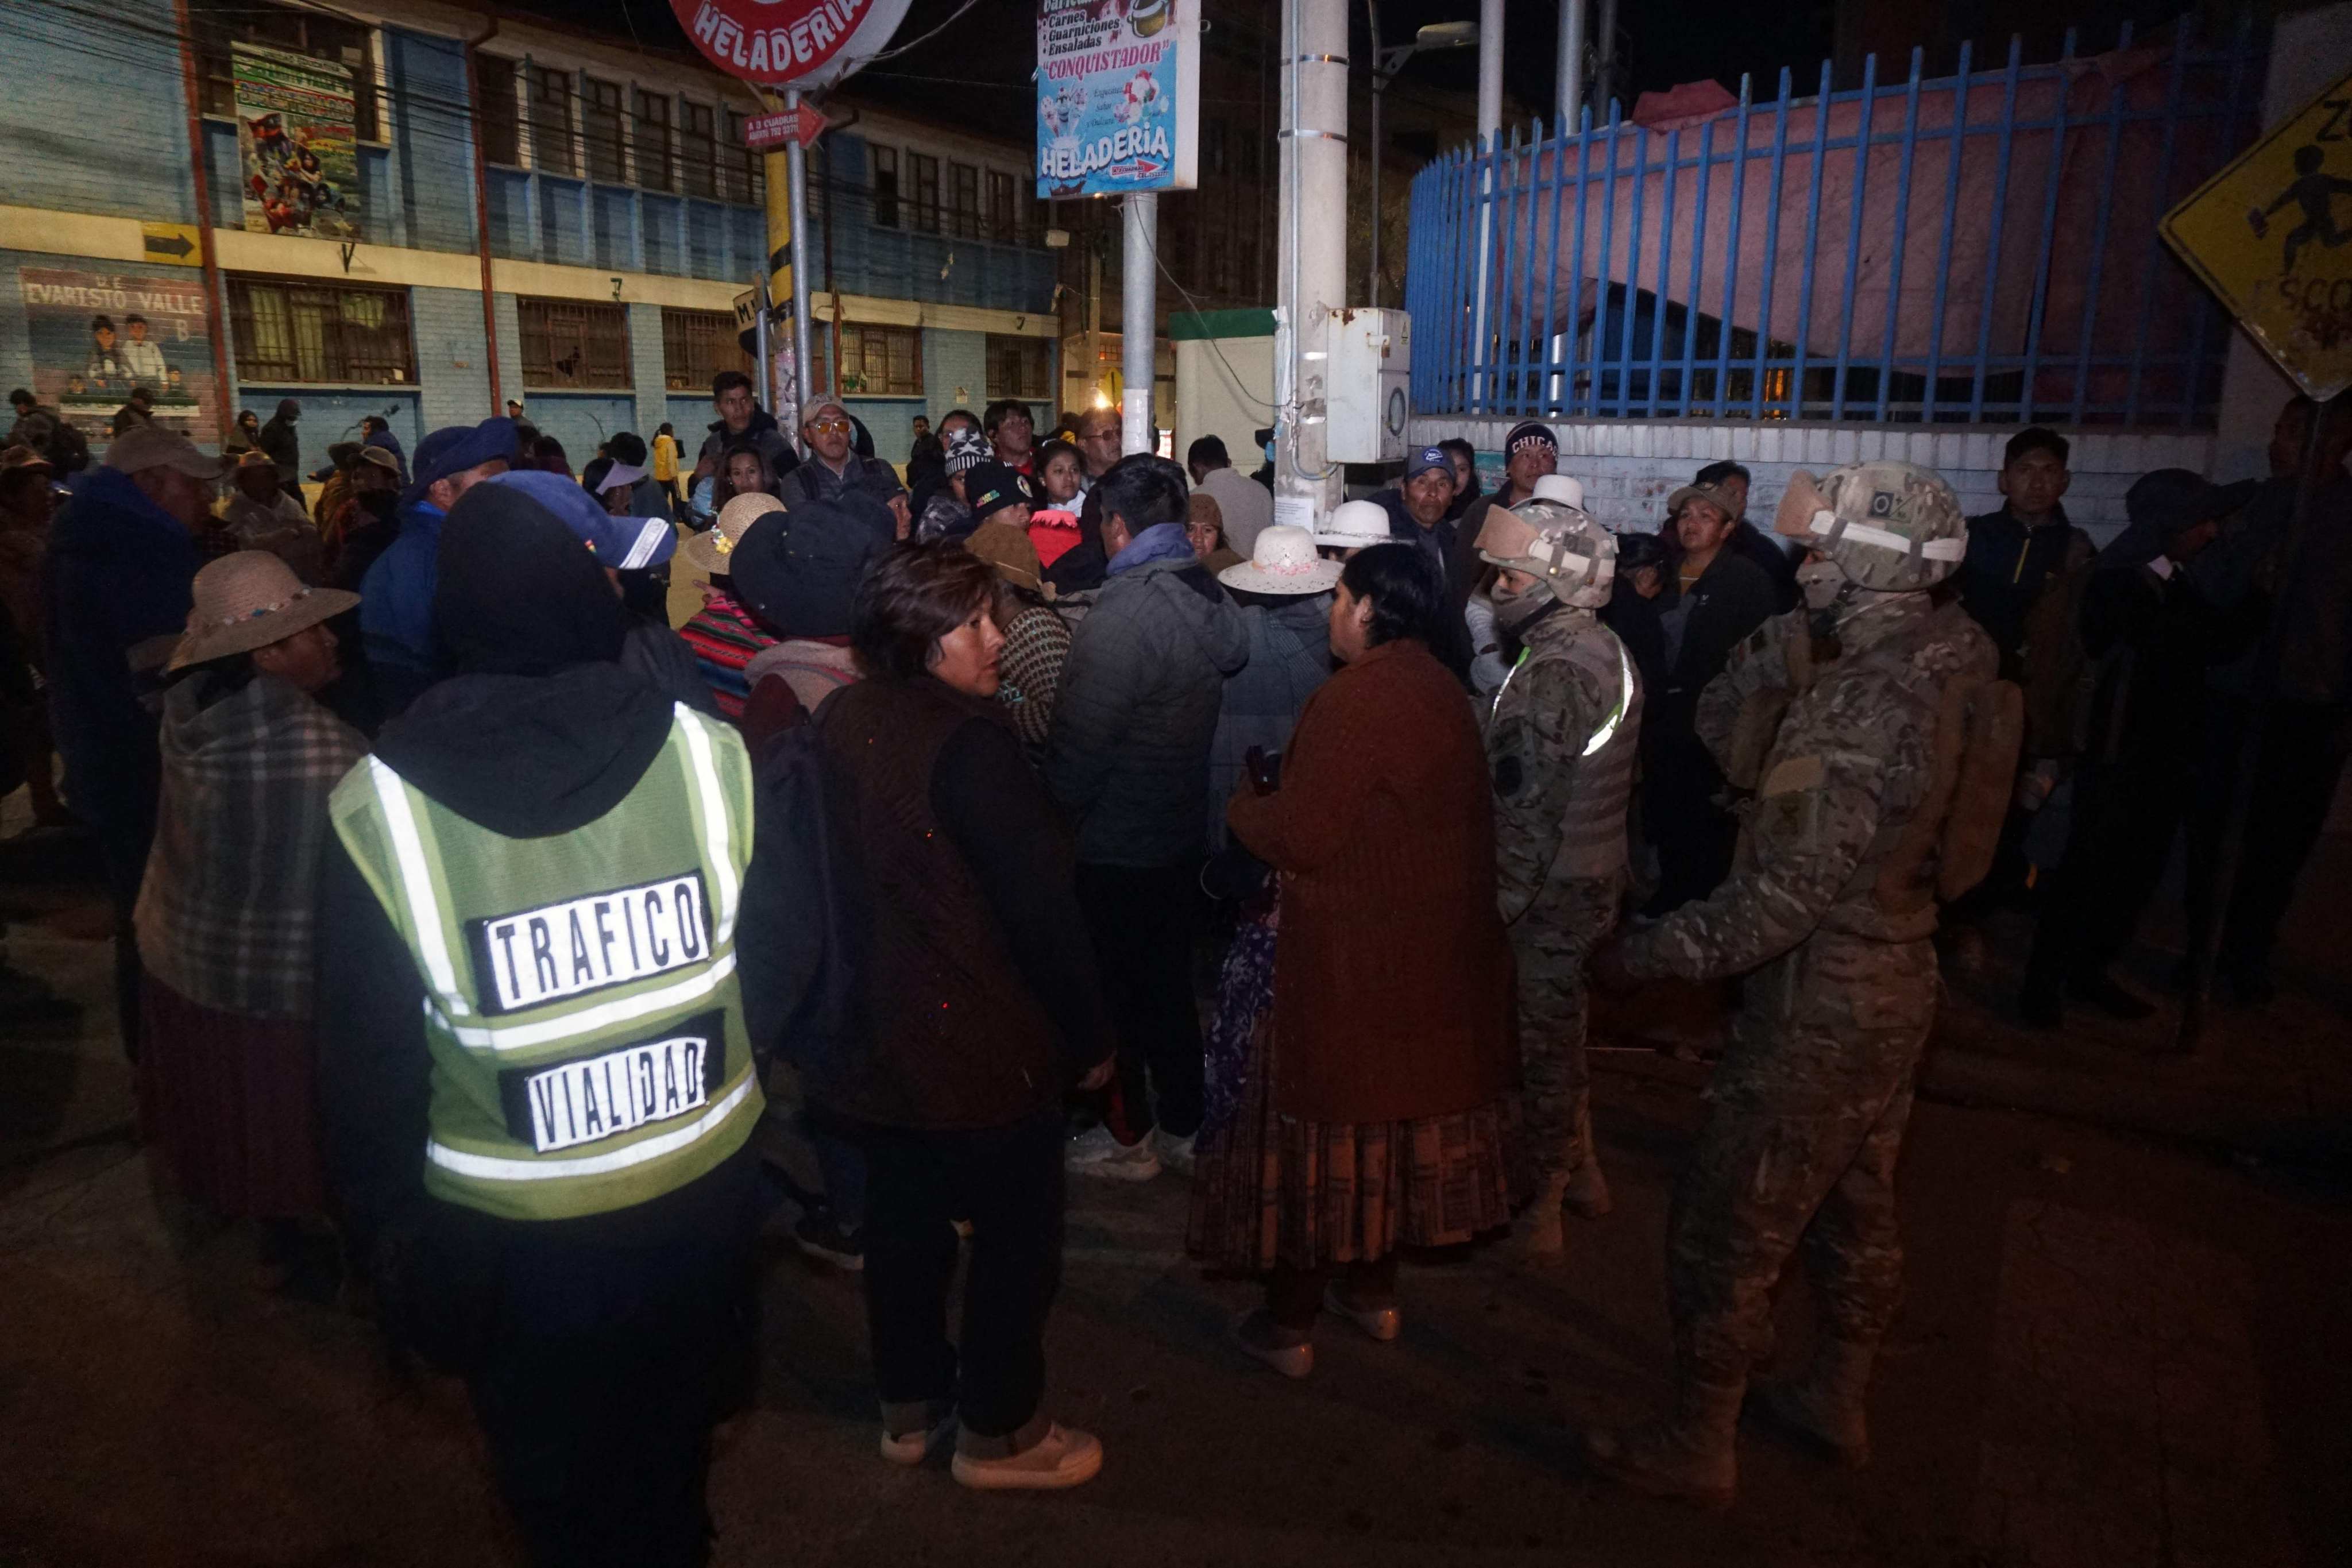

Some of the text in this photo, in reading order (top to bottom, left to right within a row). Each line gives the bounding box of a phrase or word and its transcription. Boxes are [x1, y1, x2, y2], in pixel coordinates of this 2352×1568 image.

[1049, 11, 1086, 28] Carnes
[1049, 18, 1120, 42] Guarniciones
[1048, 34, 1102, 56] Ensaladas
[26, 283, 202, 314] EVARISTO VALLE
[496, 883, 700, 1000] TRAFICO
[535, 1042, 699, 1144] VIALIDAD
